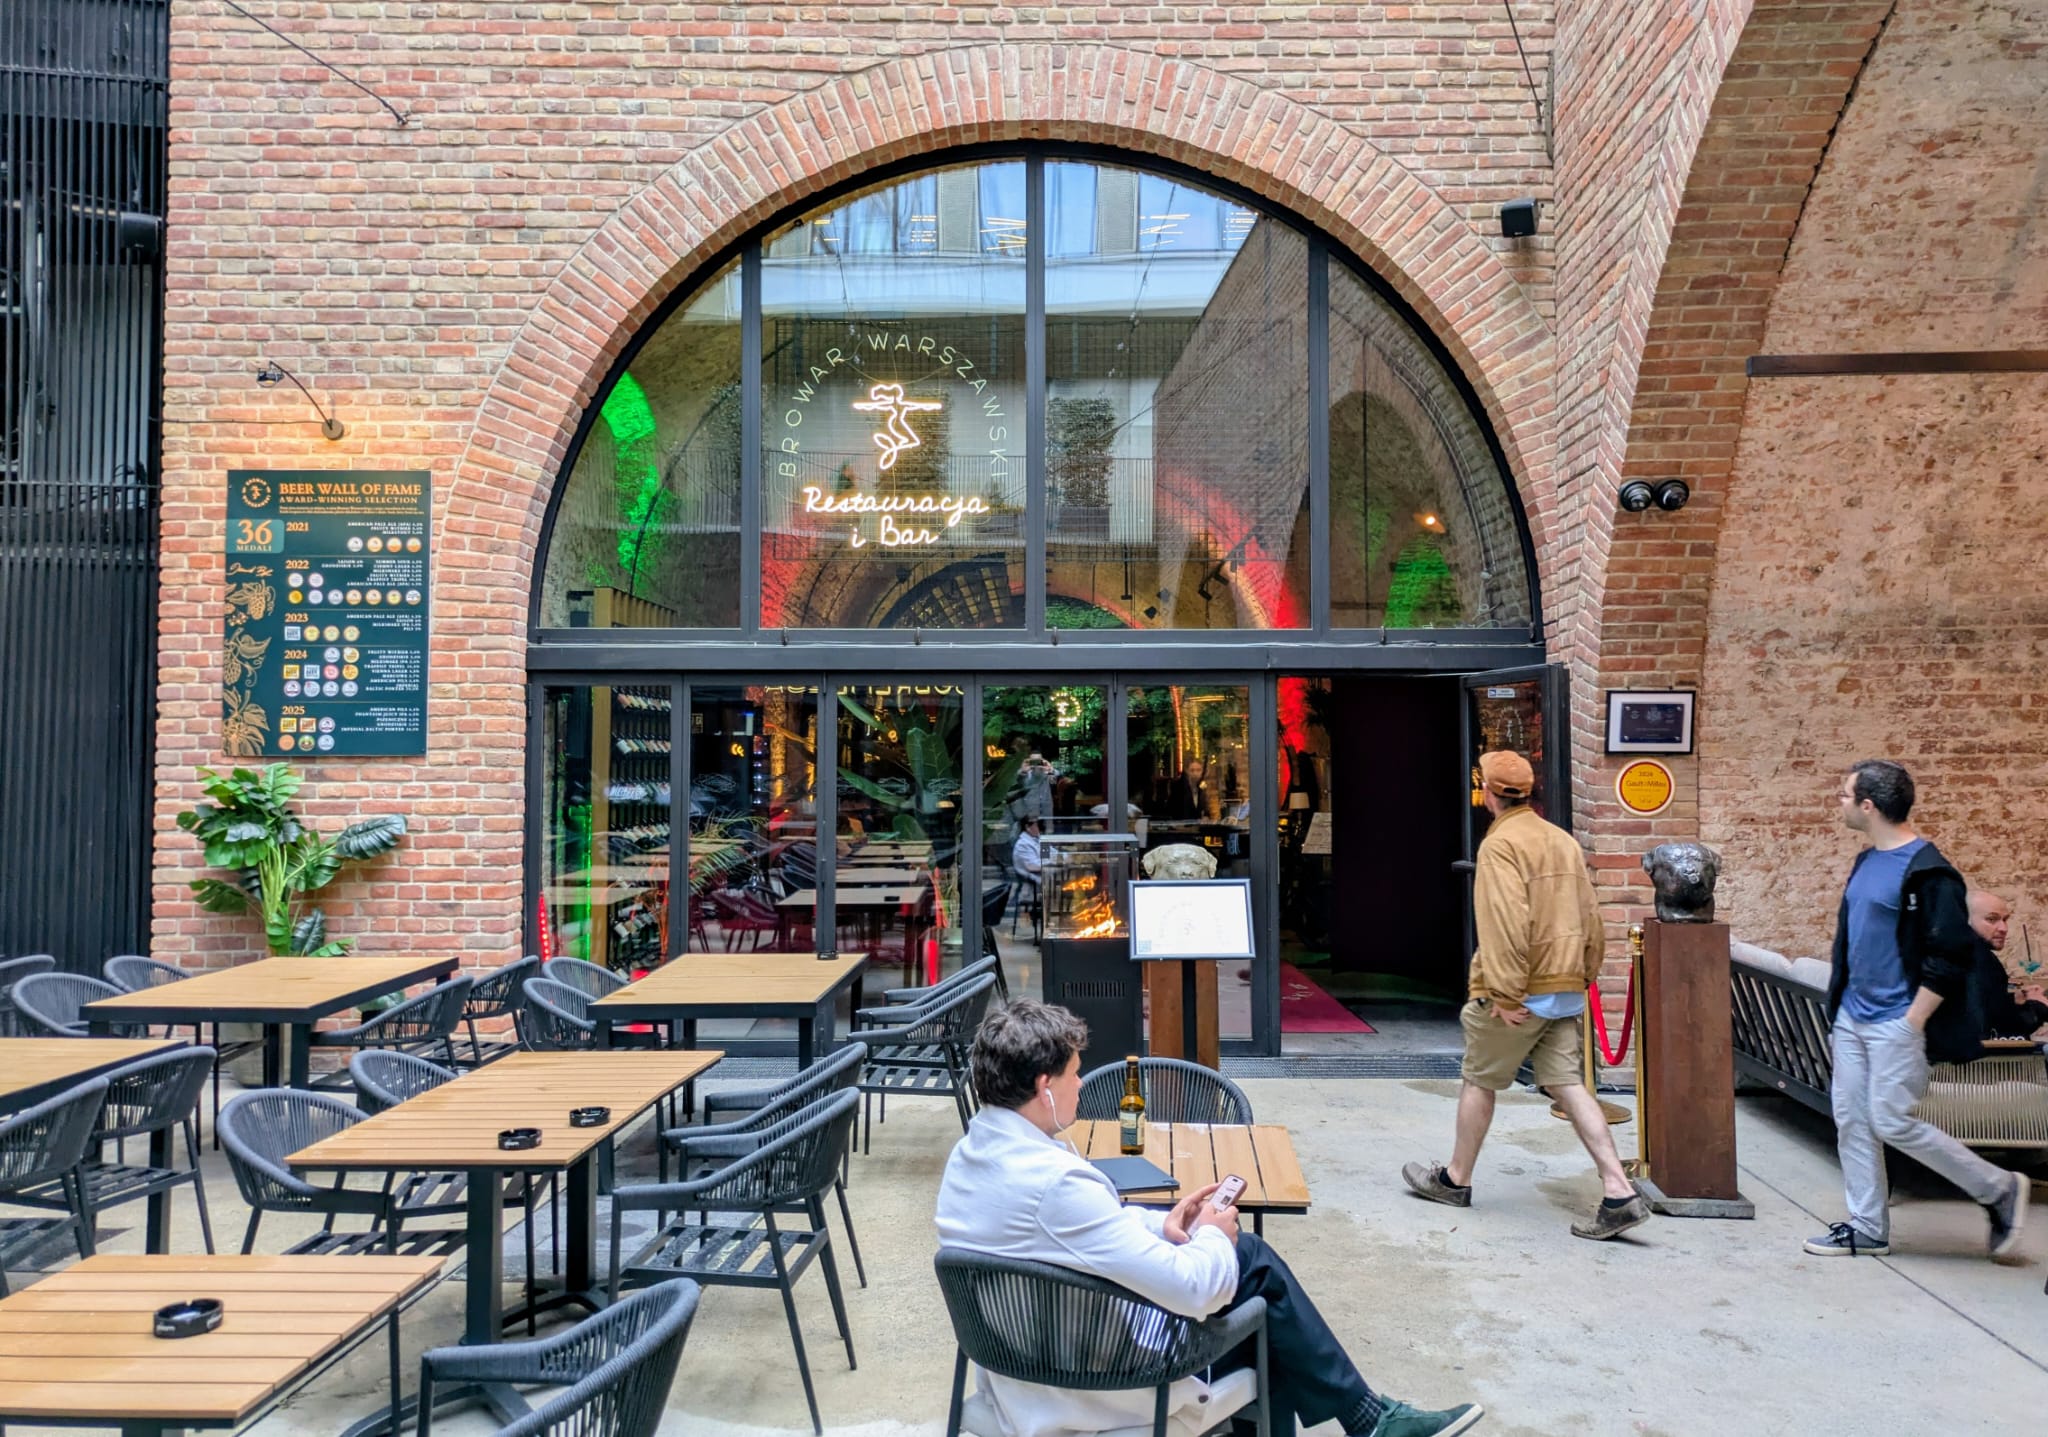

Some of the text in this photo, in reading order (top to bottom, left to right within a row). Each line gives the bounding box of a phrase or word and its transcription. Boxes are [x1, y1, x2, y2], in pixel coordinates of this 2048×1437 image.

[778, 332, 1008, 477] BROWAR WARSZAWSKI
[279, 483, 314, 495] BEER
[317, 483, 359, 495] WALL
[361, 483, 381, 495] OF
[384, 484, 422, 496] FAME
[279, 496, 419, 504] AWARD-WINNING SELECTION
[803, 485, 990, 528] Restauracja
[236, 519, 273, 545] 36
[286, 522, 309, 532] 2021
[851, 515, 940, 549] i Bar
[285, 559, 310, 569] 2022
[284, 613, 309, 623] 2023
[284, 650, 307, 659] 2024
[281, 706, 305, 715] 2025
